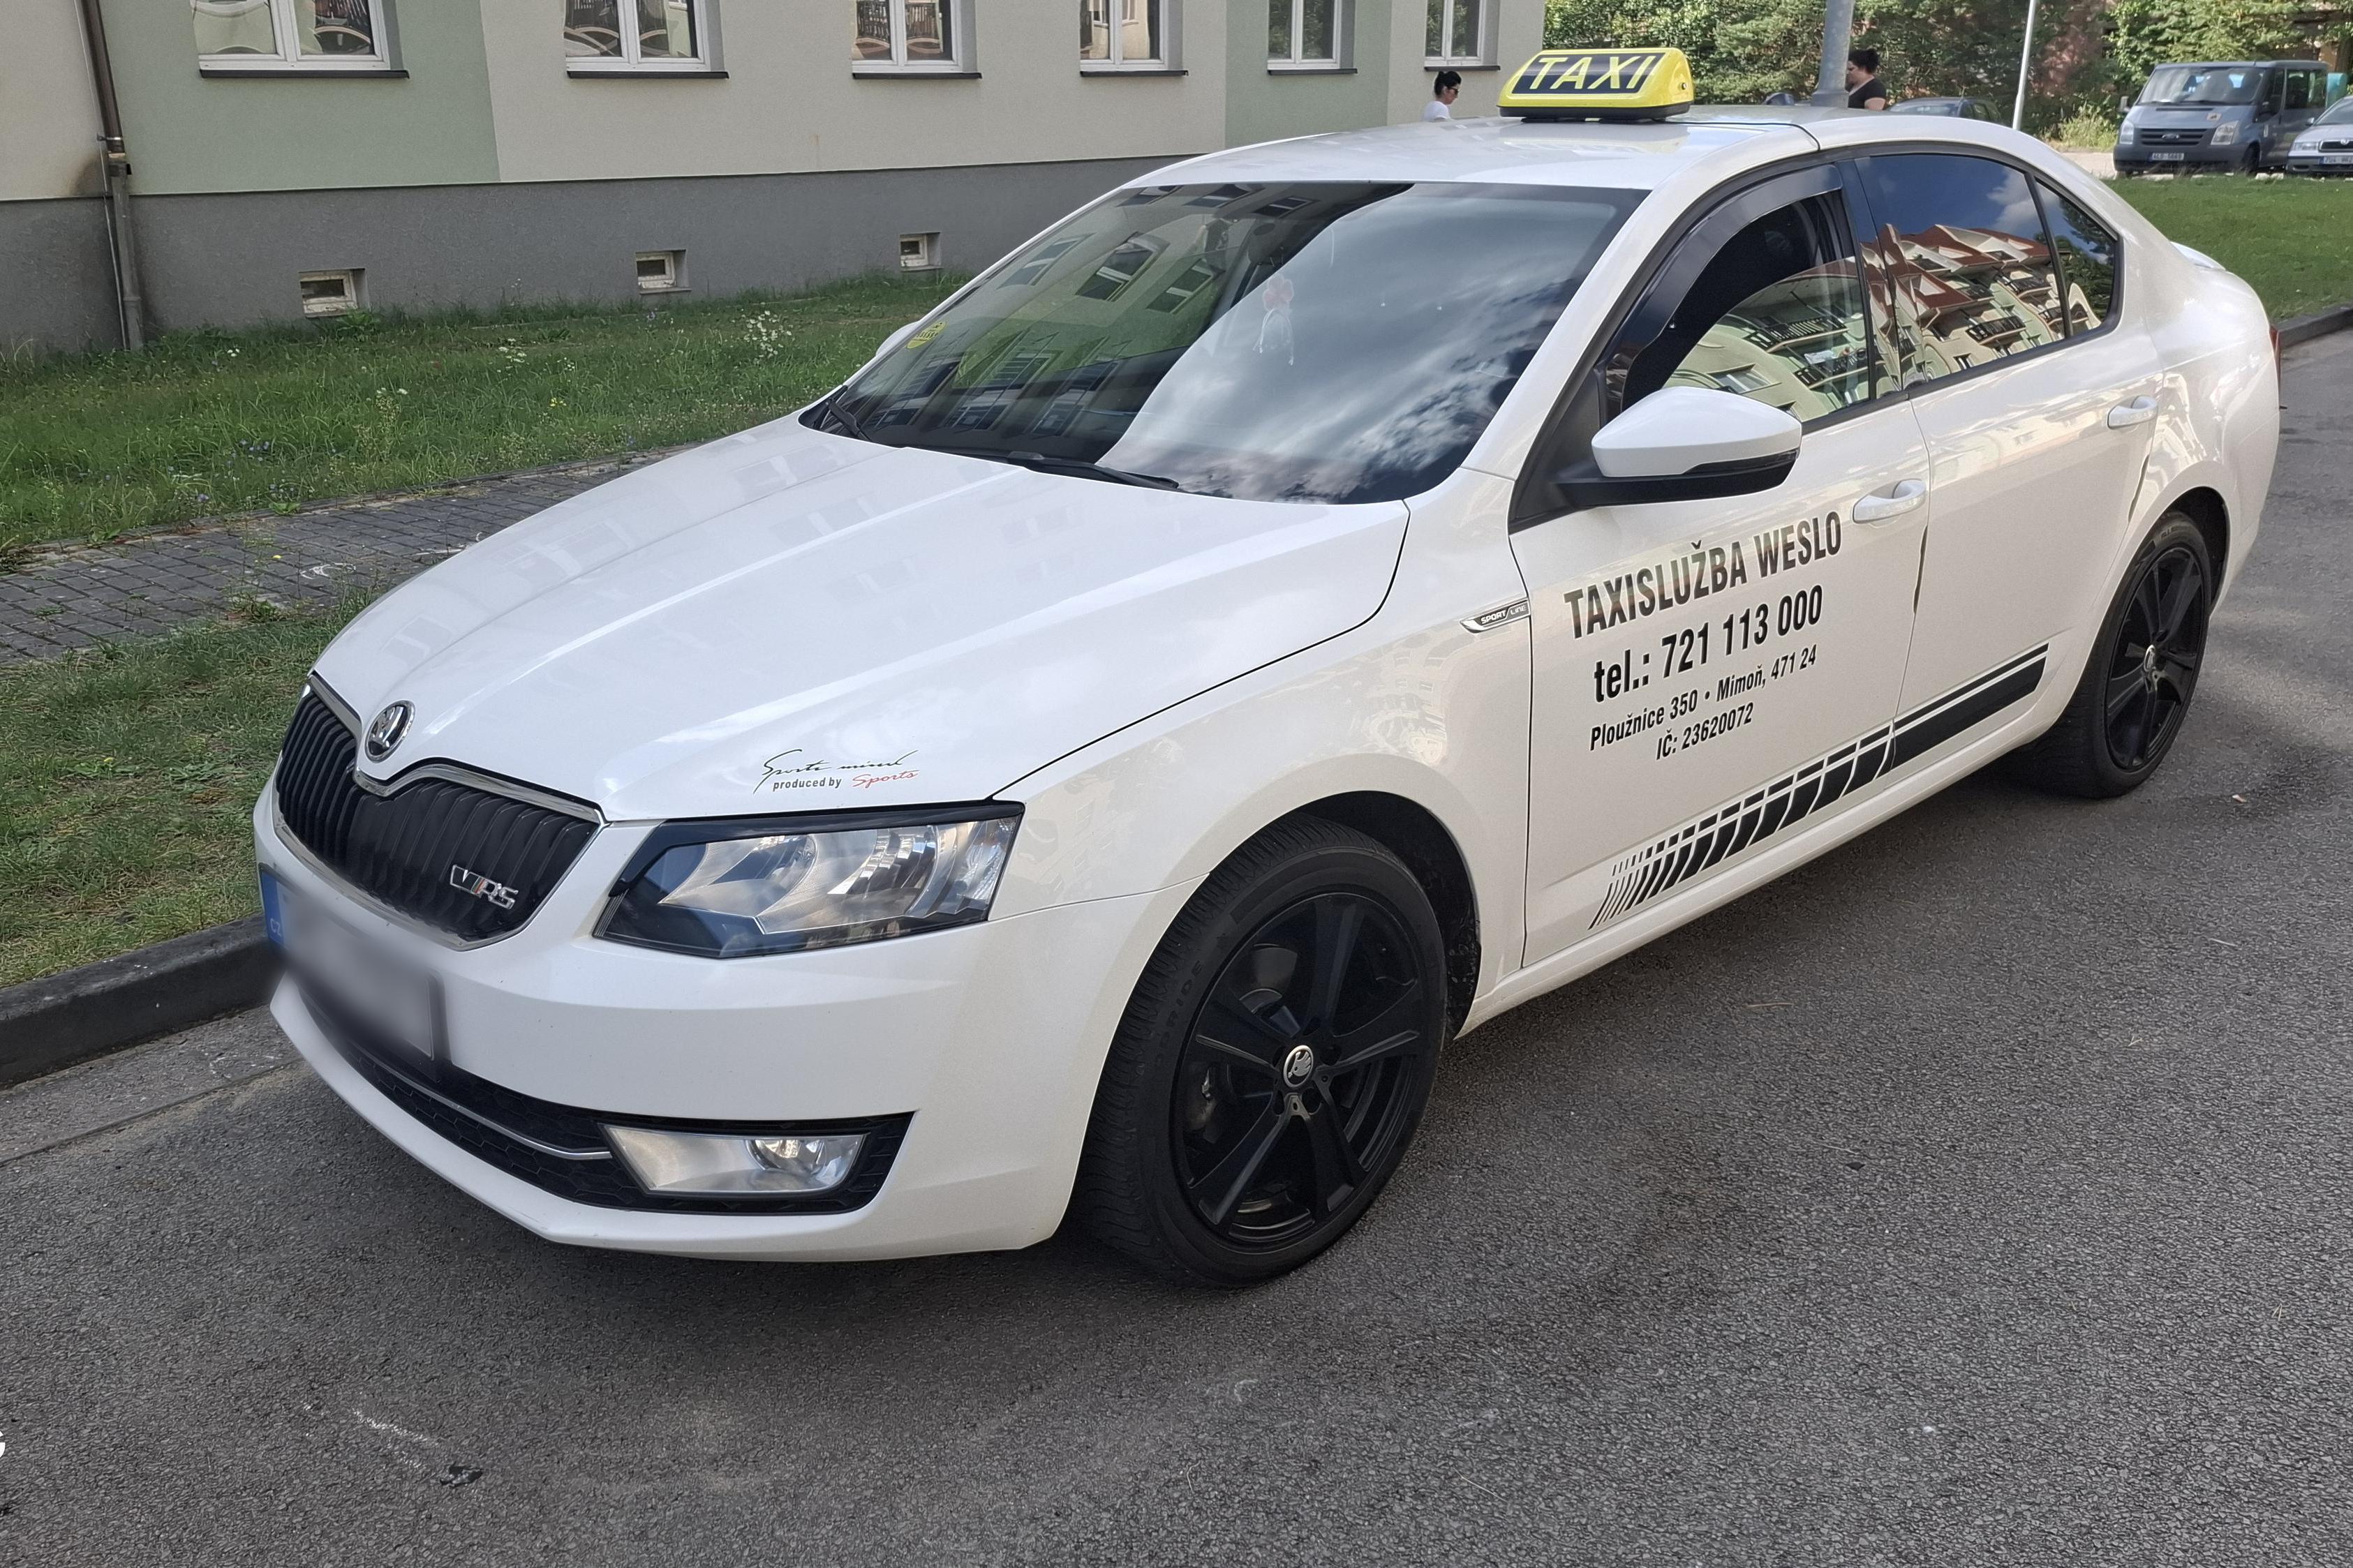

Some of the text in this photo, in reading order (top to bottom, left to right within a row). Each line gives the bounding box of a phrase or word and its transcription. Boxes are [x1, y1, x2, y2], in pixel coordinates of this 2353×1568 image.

[1529, 55, 1657, 90] TAXI
[1564, 512, 1842, 639] TAXISLUŽBA WESLO
[1480, 610, 1506, 625] SPORT
[1594, 585, 1823, 703] tel.: 721 113 000
[1590, 643, 1817, 752] Ploužnice 350 Mimoň, 471 24
[1656, 702, 1754, 760] IČ: 23620072
[773, 770, 920, 792] produced by Sports
[269, 917, 282, 938] CZ
